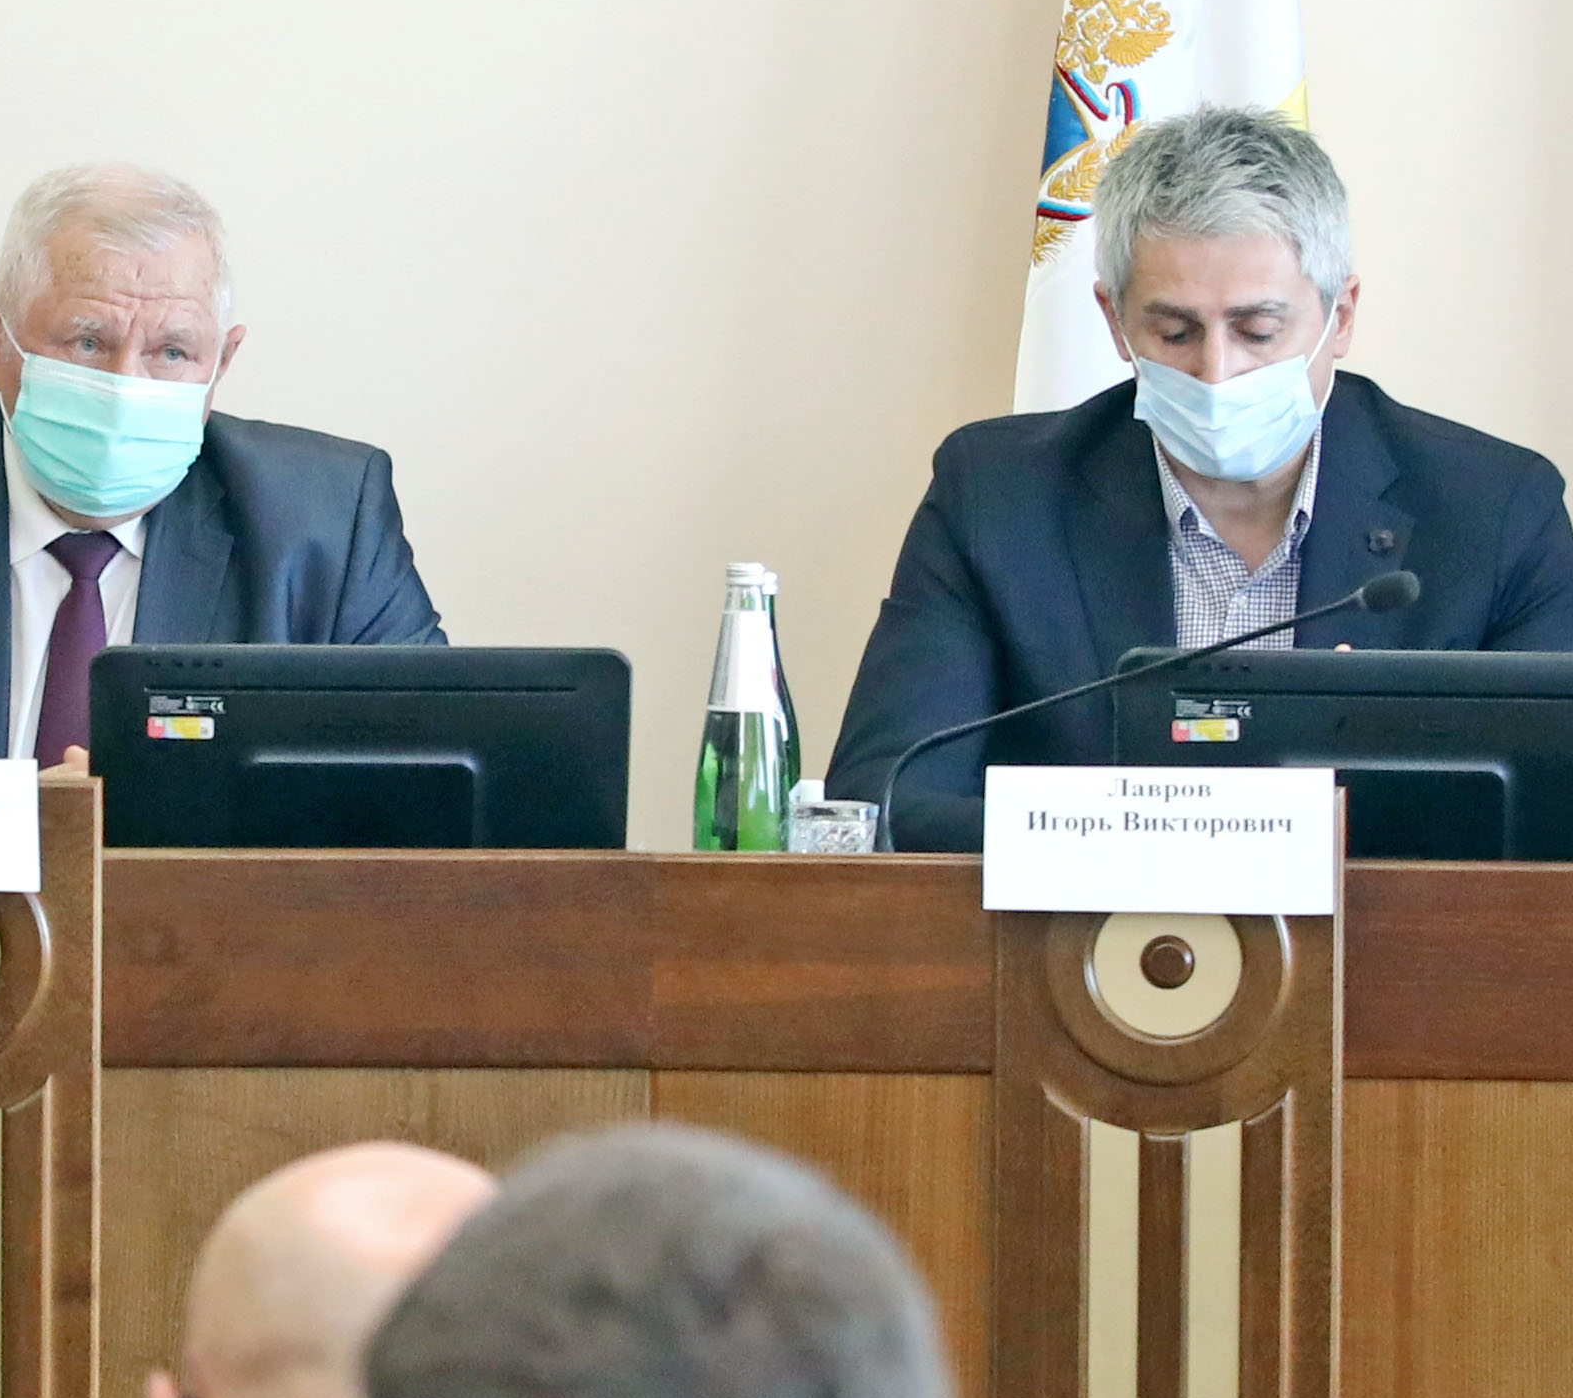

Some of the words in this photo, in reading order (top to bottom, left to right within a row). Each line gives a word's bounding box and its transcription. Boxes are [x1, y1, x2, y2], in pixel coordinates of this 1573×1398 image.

[1107, 778, 1212, 804] Лавров
[1028, 810, 1113, 837] Игорь
[1123, 811, 1292, 839] Викторович
